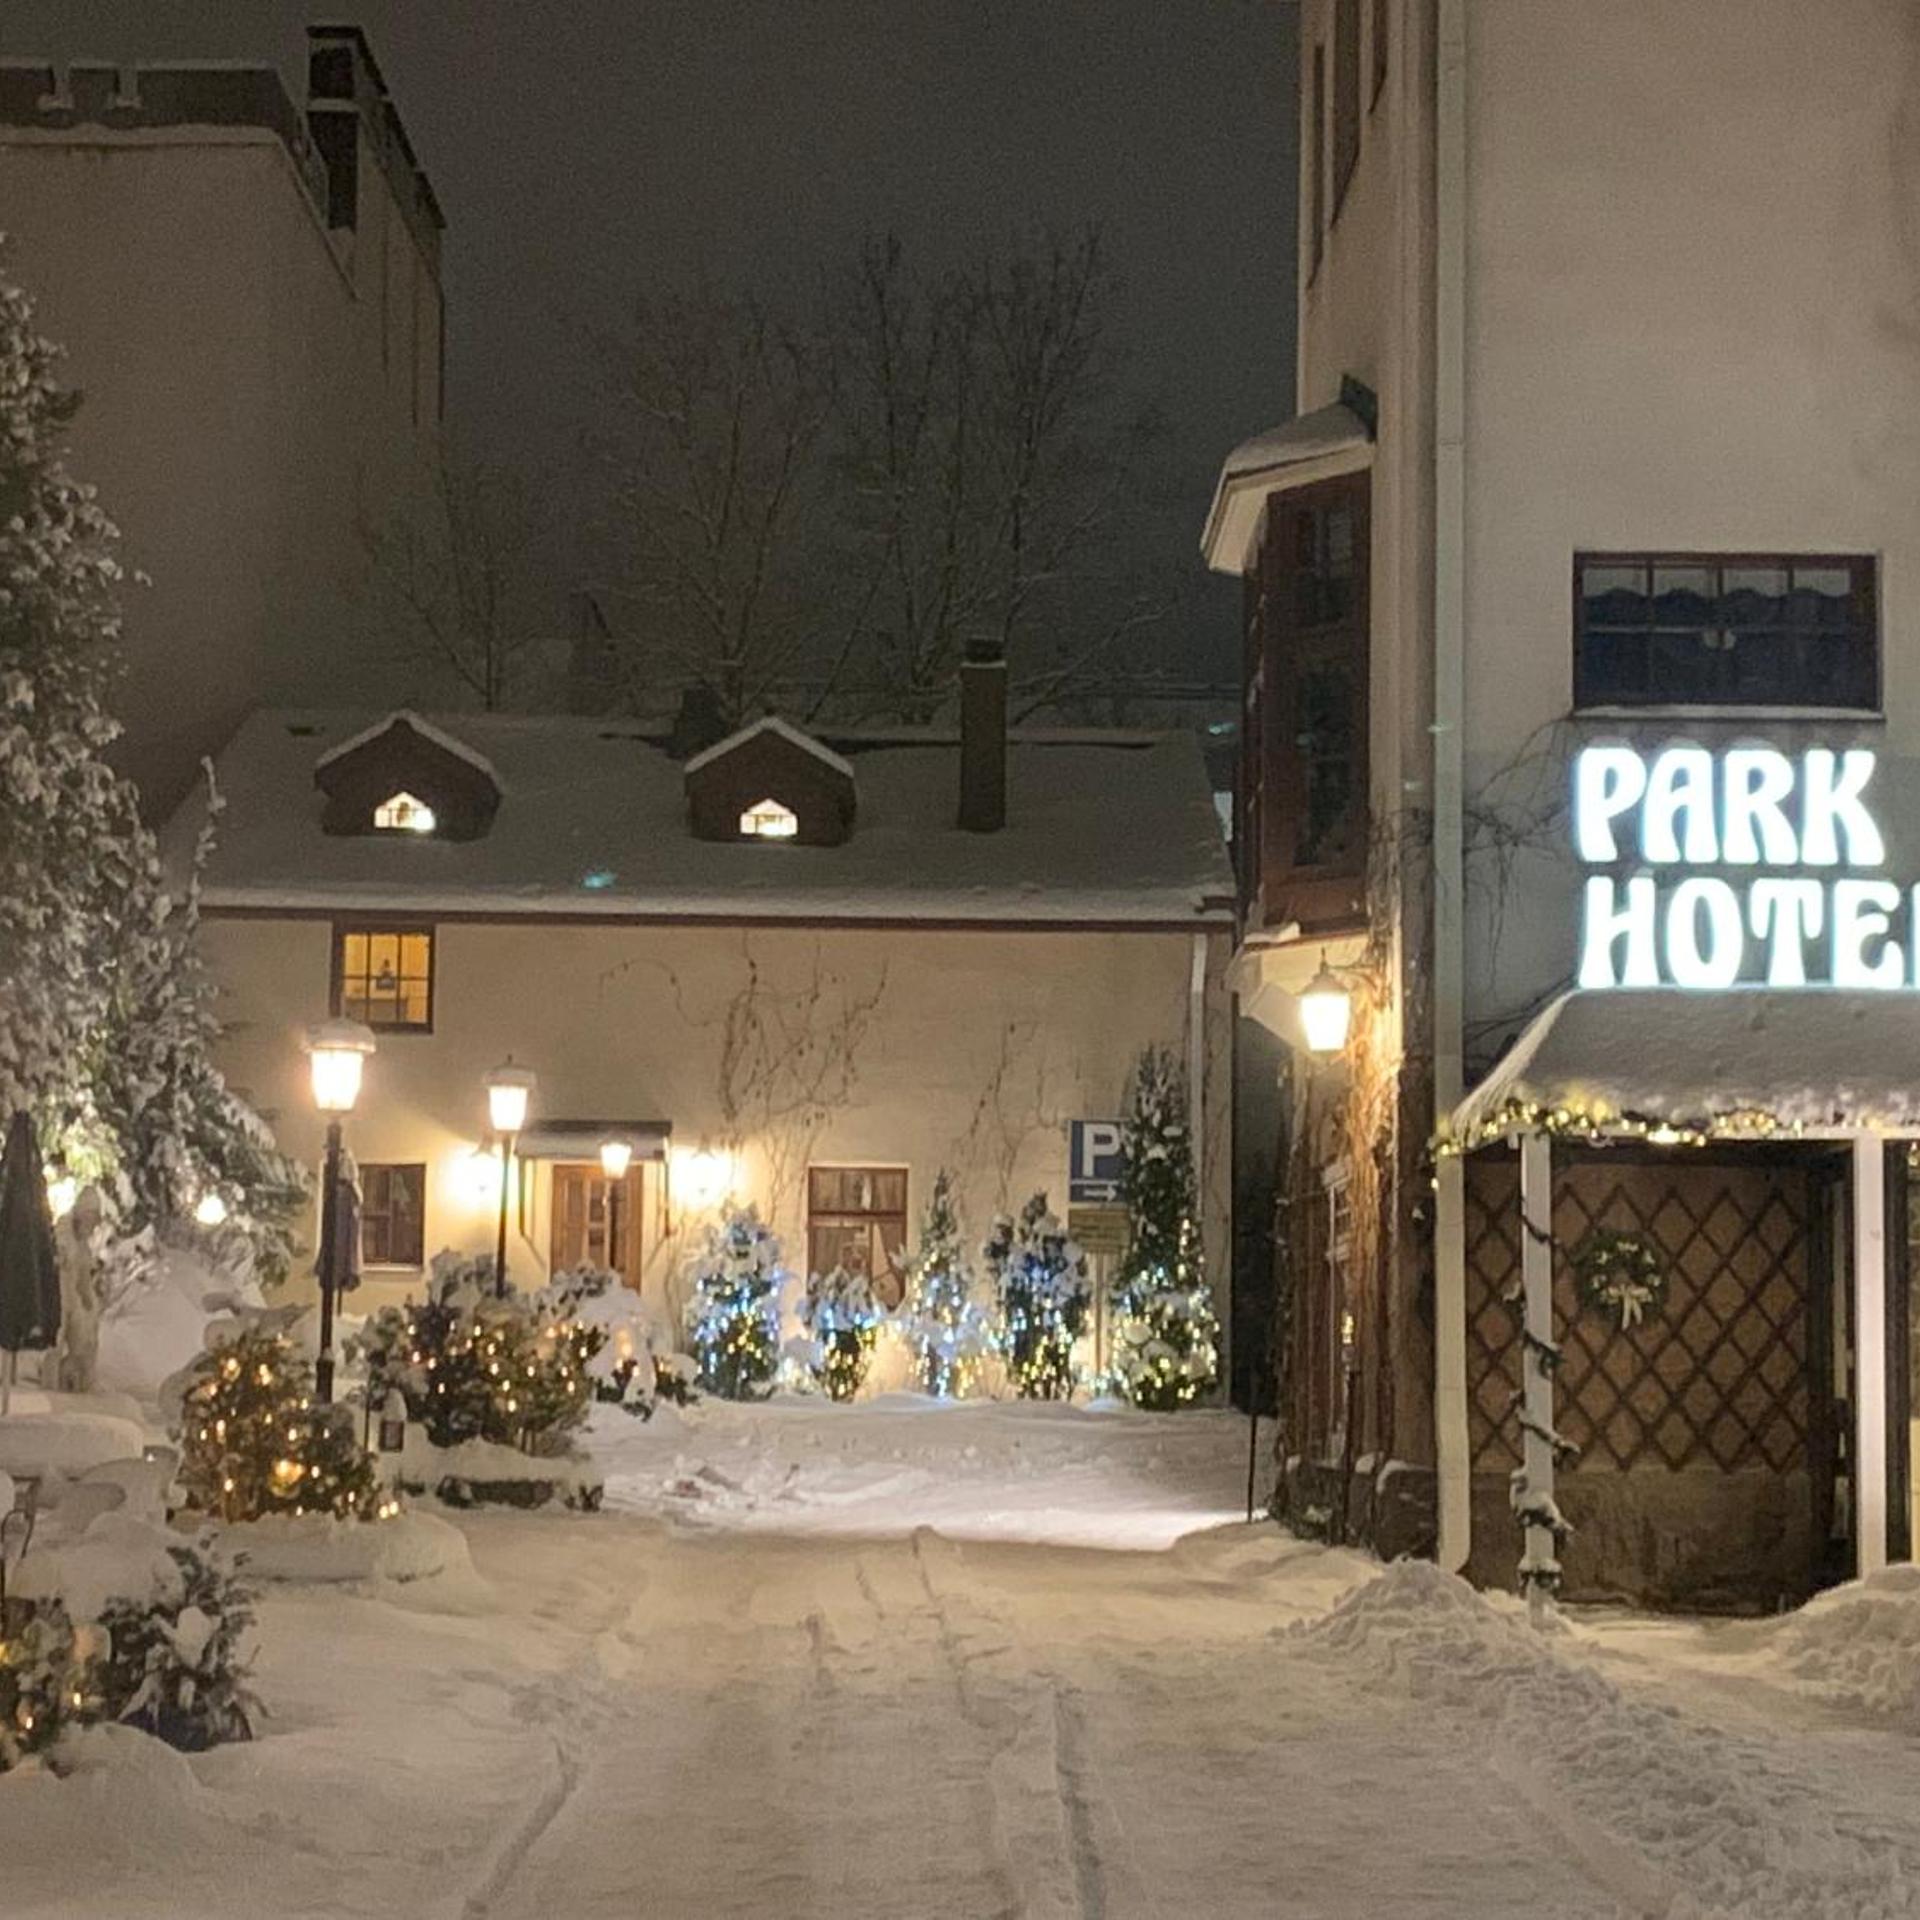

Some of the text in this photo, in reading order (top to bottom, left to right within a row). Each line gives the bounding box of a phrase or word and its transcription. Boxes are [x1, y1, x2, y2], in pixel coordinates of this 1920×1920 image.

[1576, 746, 1885, 866] PARK
[1578, 874, 1920, 989] HOTE
[1083, 1122, 1120, 1177] P
